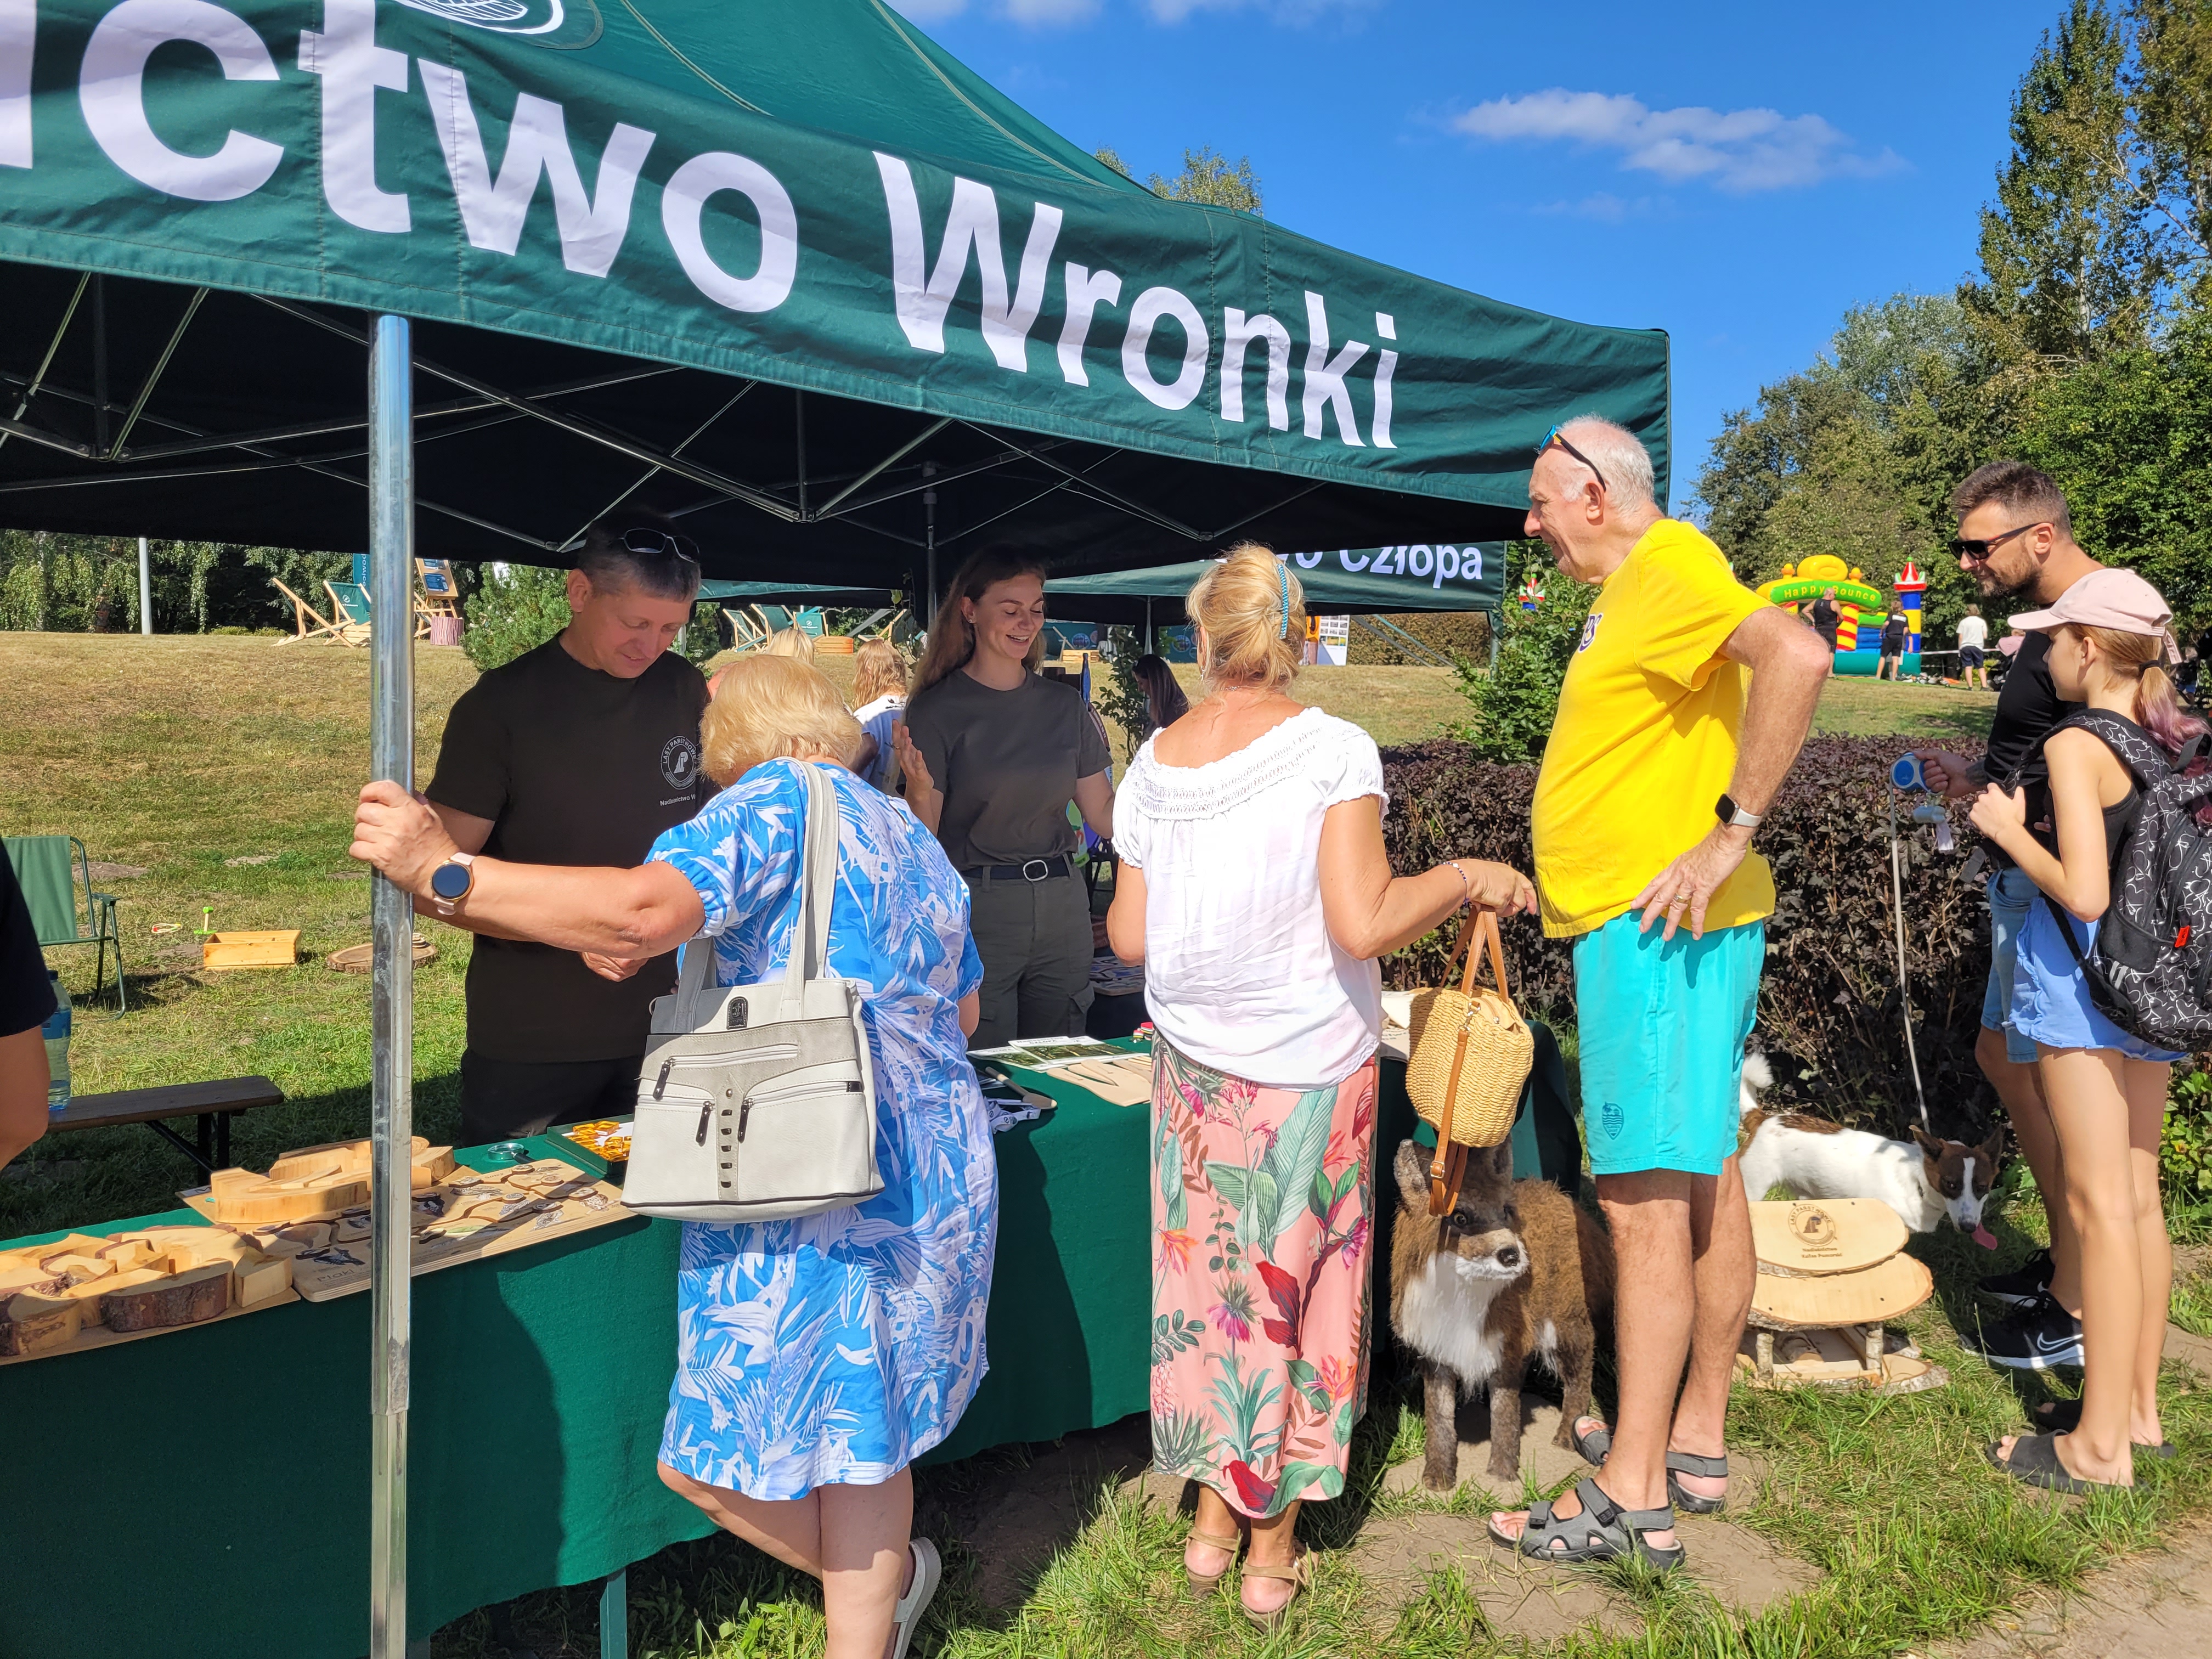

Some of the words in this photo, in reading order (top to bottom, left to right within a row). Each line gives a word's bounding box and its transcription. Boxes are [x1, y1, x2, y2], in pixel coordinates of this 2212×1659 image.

[873, 151, 1398, 449] Wronki
[1784, 585, 1825, 599] Happy
[1832, 585, 1876, 602] Bounce
[663, 747, 671, 764] LASY
